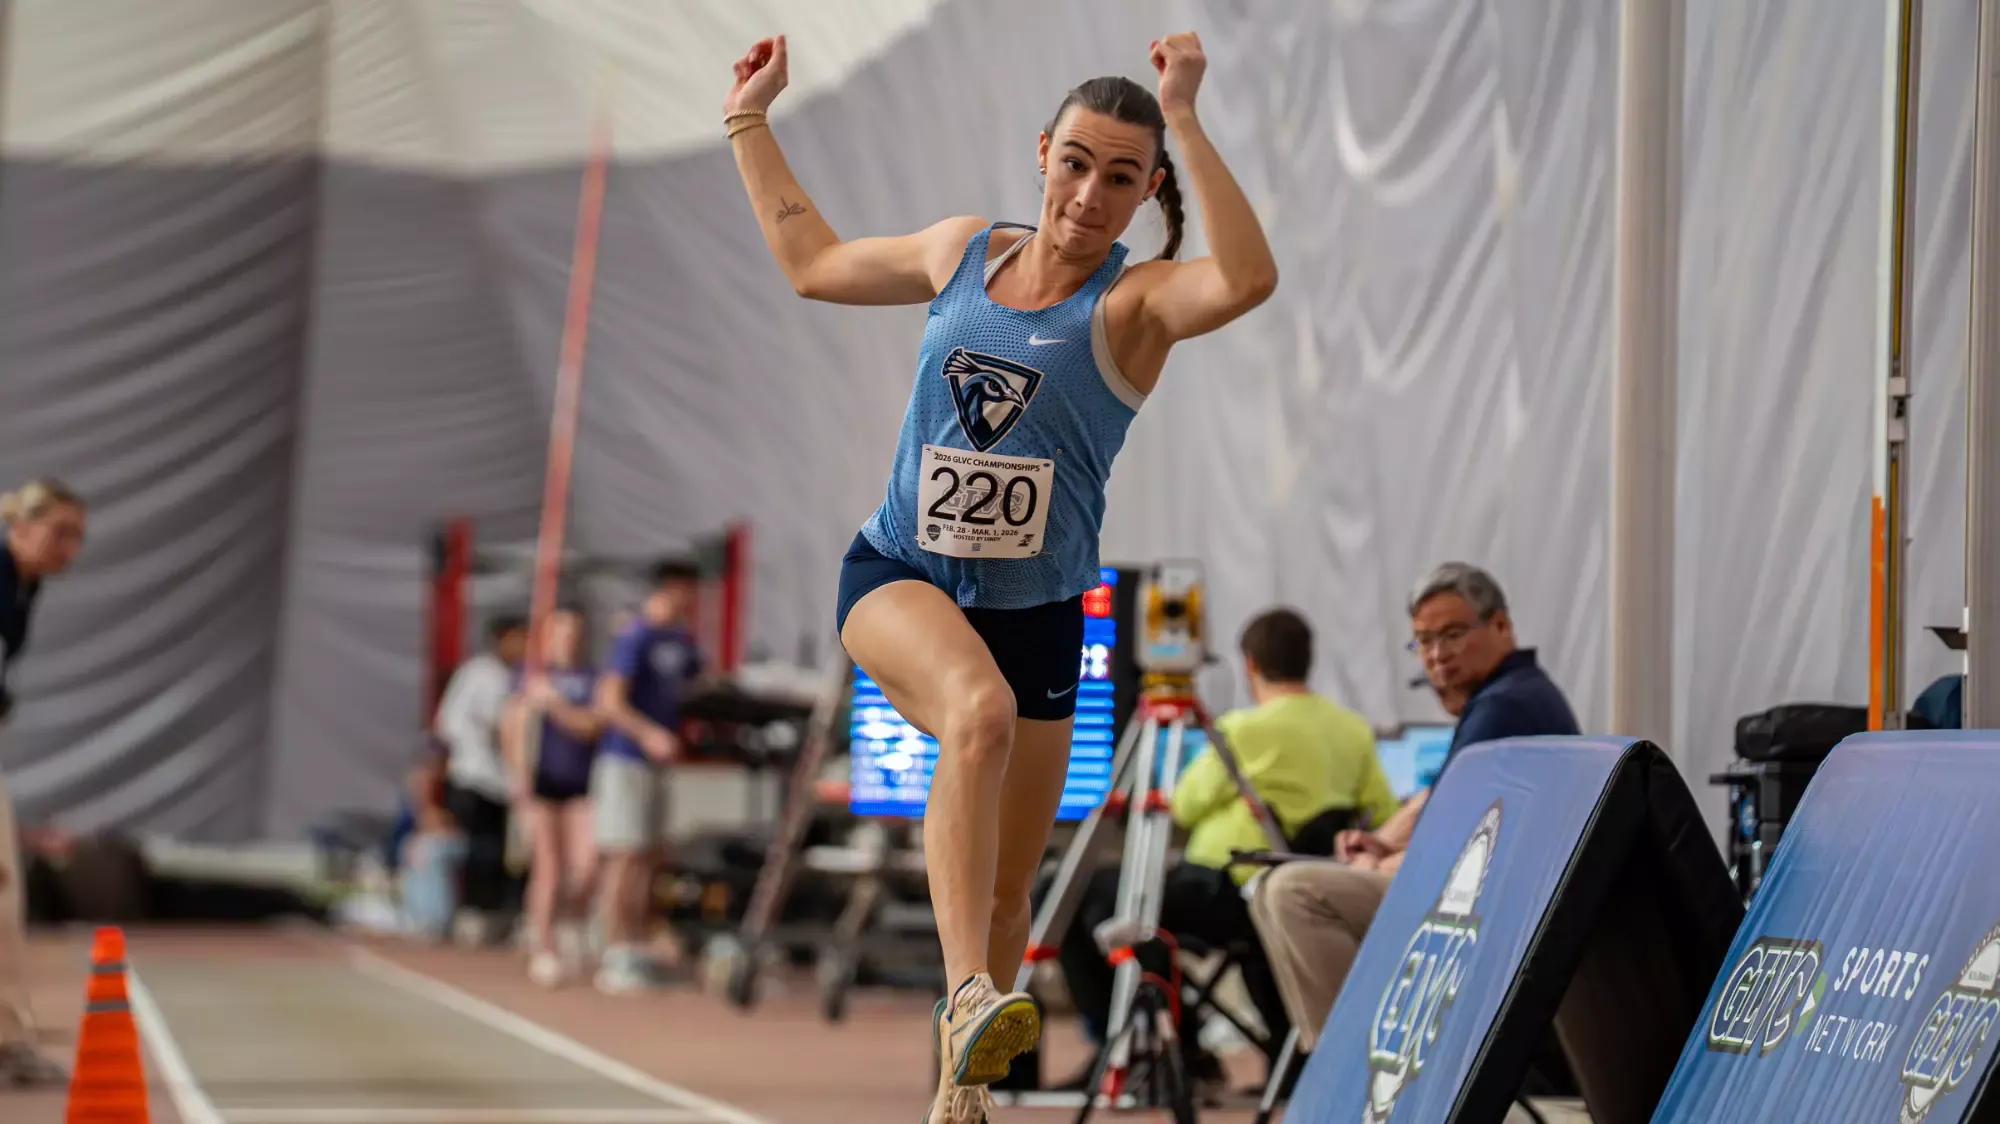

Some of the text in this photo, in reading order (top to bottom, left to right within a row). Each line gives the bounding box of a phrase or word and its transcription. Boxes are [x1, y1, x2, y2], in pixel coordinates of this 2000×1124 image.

[934, 452, 1041, 472] 2026 GLVC CHAMPIONSHIPS
[928, 466, 1037, 527] 220
[956, 526, 966, 534] 28
[971, 528, 992, 536] MAR.
[1708, 940, 1822, 1053] GLVC
[1833, 946, 1930, 1001] SPORTS
[1902, 989, 2000, 1088] GLVC
